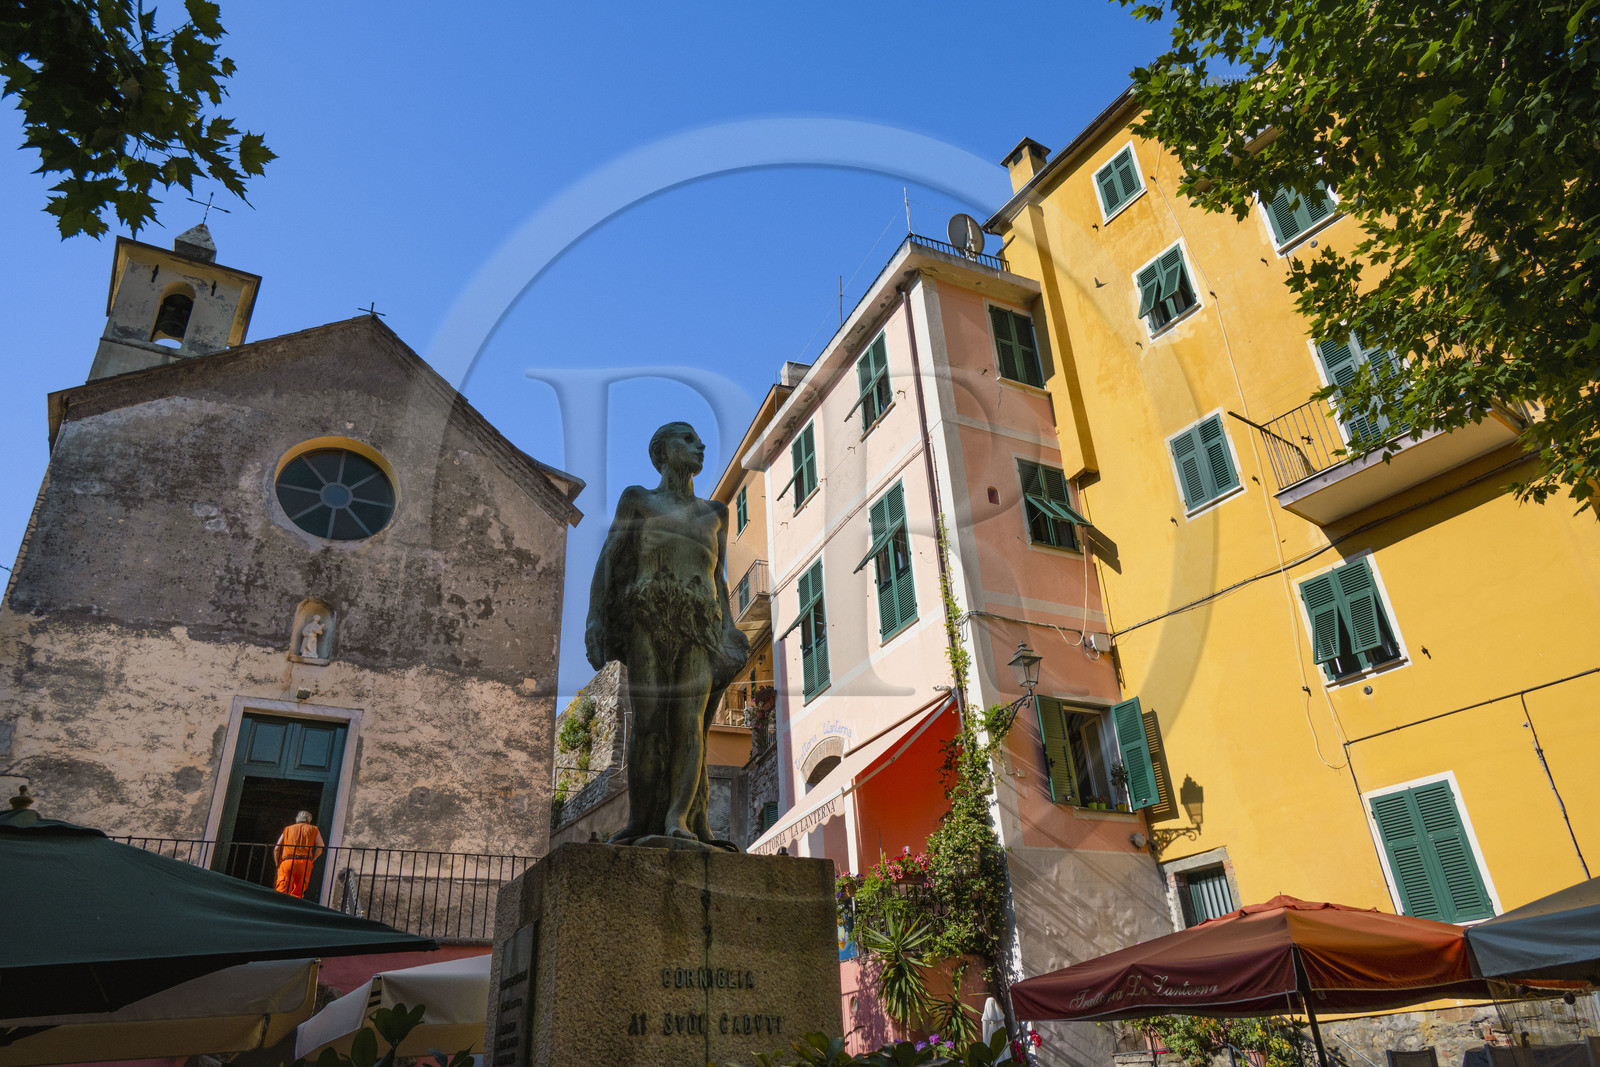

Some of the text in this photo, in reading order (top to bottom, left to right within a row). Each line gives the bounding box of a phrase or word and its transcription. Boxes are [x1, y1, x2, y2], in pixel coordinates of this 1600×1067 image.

[661, 967, 755, 989] CORNIGLIA
[1127, 975, 1149, 997] La
[1152, 974, 1219, 996] Lanterna
